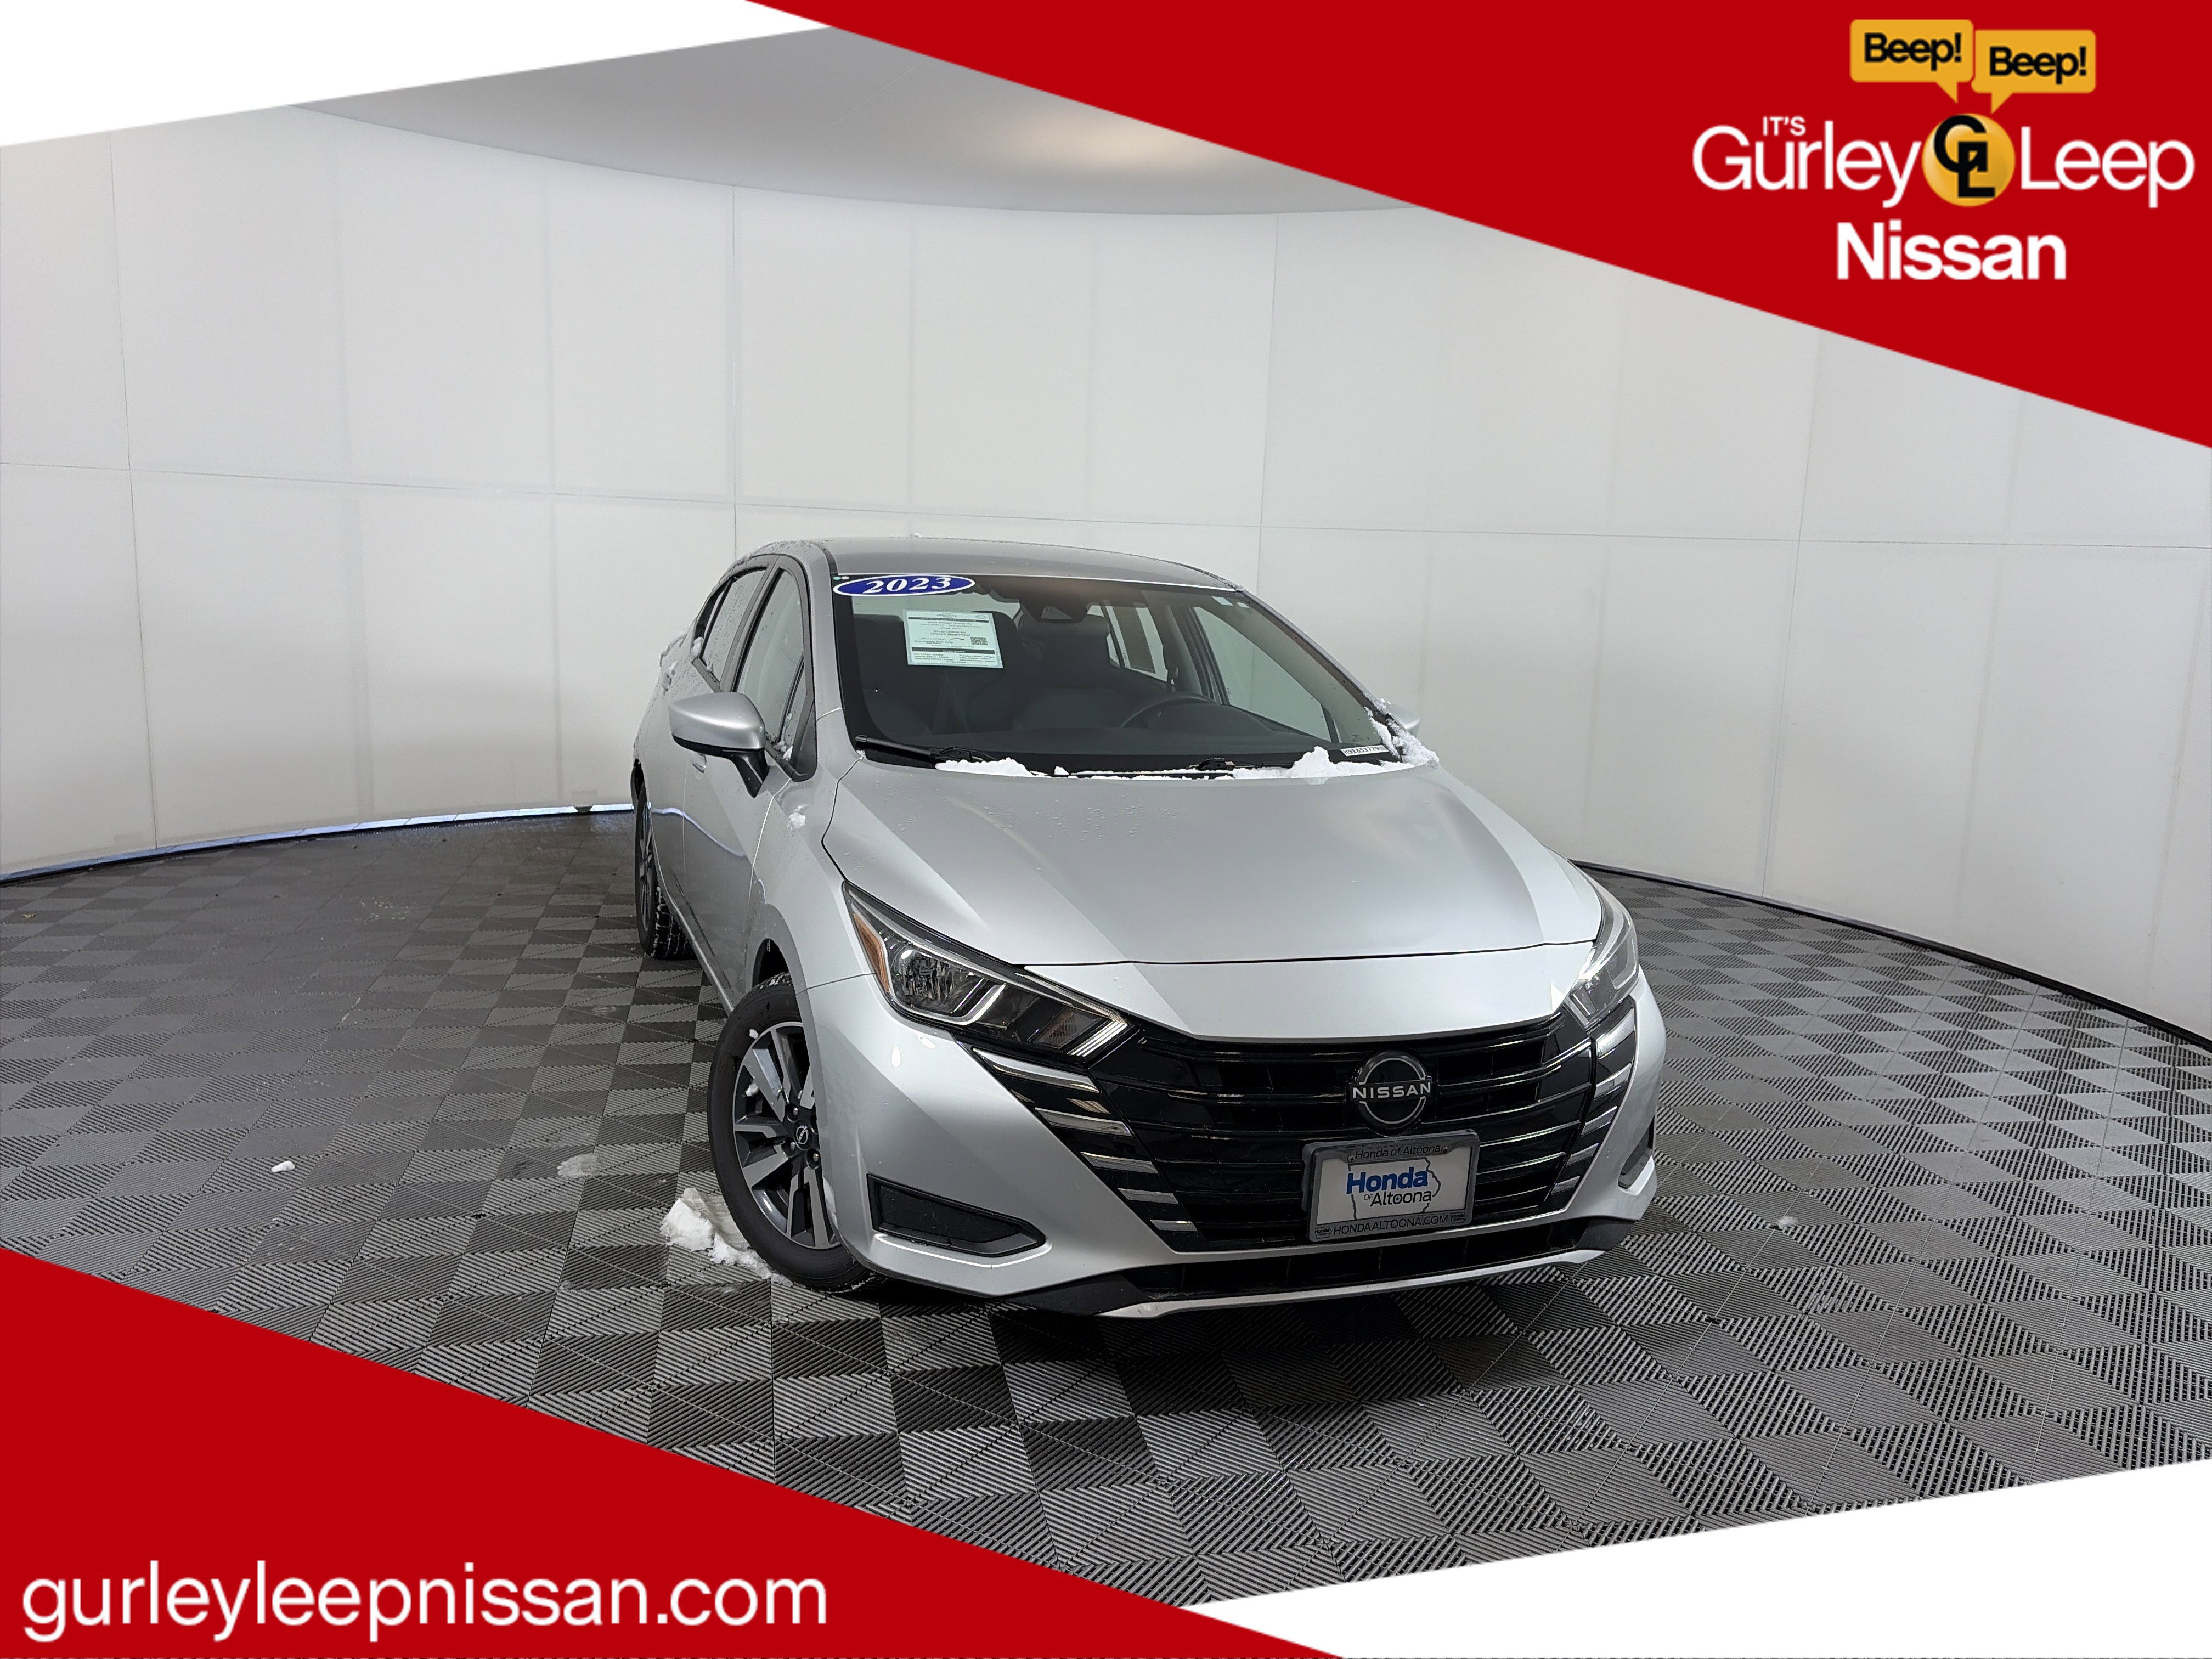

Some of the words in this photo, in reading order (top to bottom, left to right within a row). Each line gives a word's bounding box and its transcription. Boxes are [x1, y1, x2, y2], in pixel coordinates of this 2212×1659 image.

[862, 577, 952, 594] 2023
[1352, 1081, 1431, 1099] NISSAN
[1355, 1148, 1389, 1160] Honda
[1390, 1146, 1401, 1156] of
[1402, 1145, 1441, 1155] Altoona
[1346, 1166, 1429, 1195] Honda
[1370, 1190, 1432, 1207] Altoona
